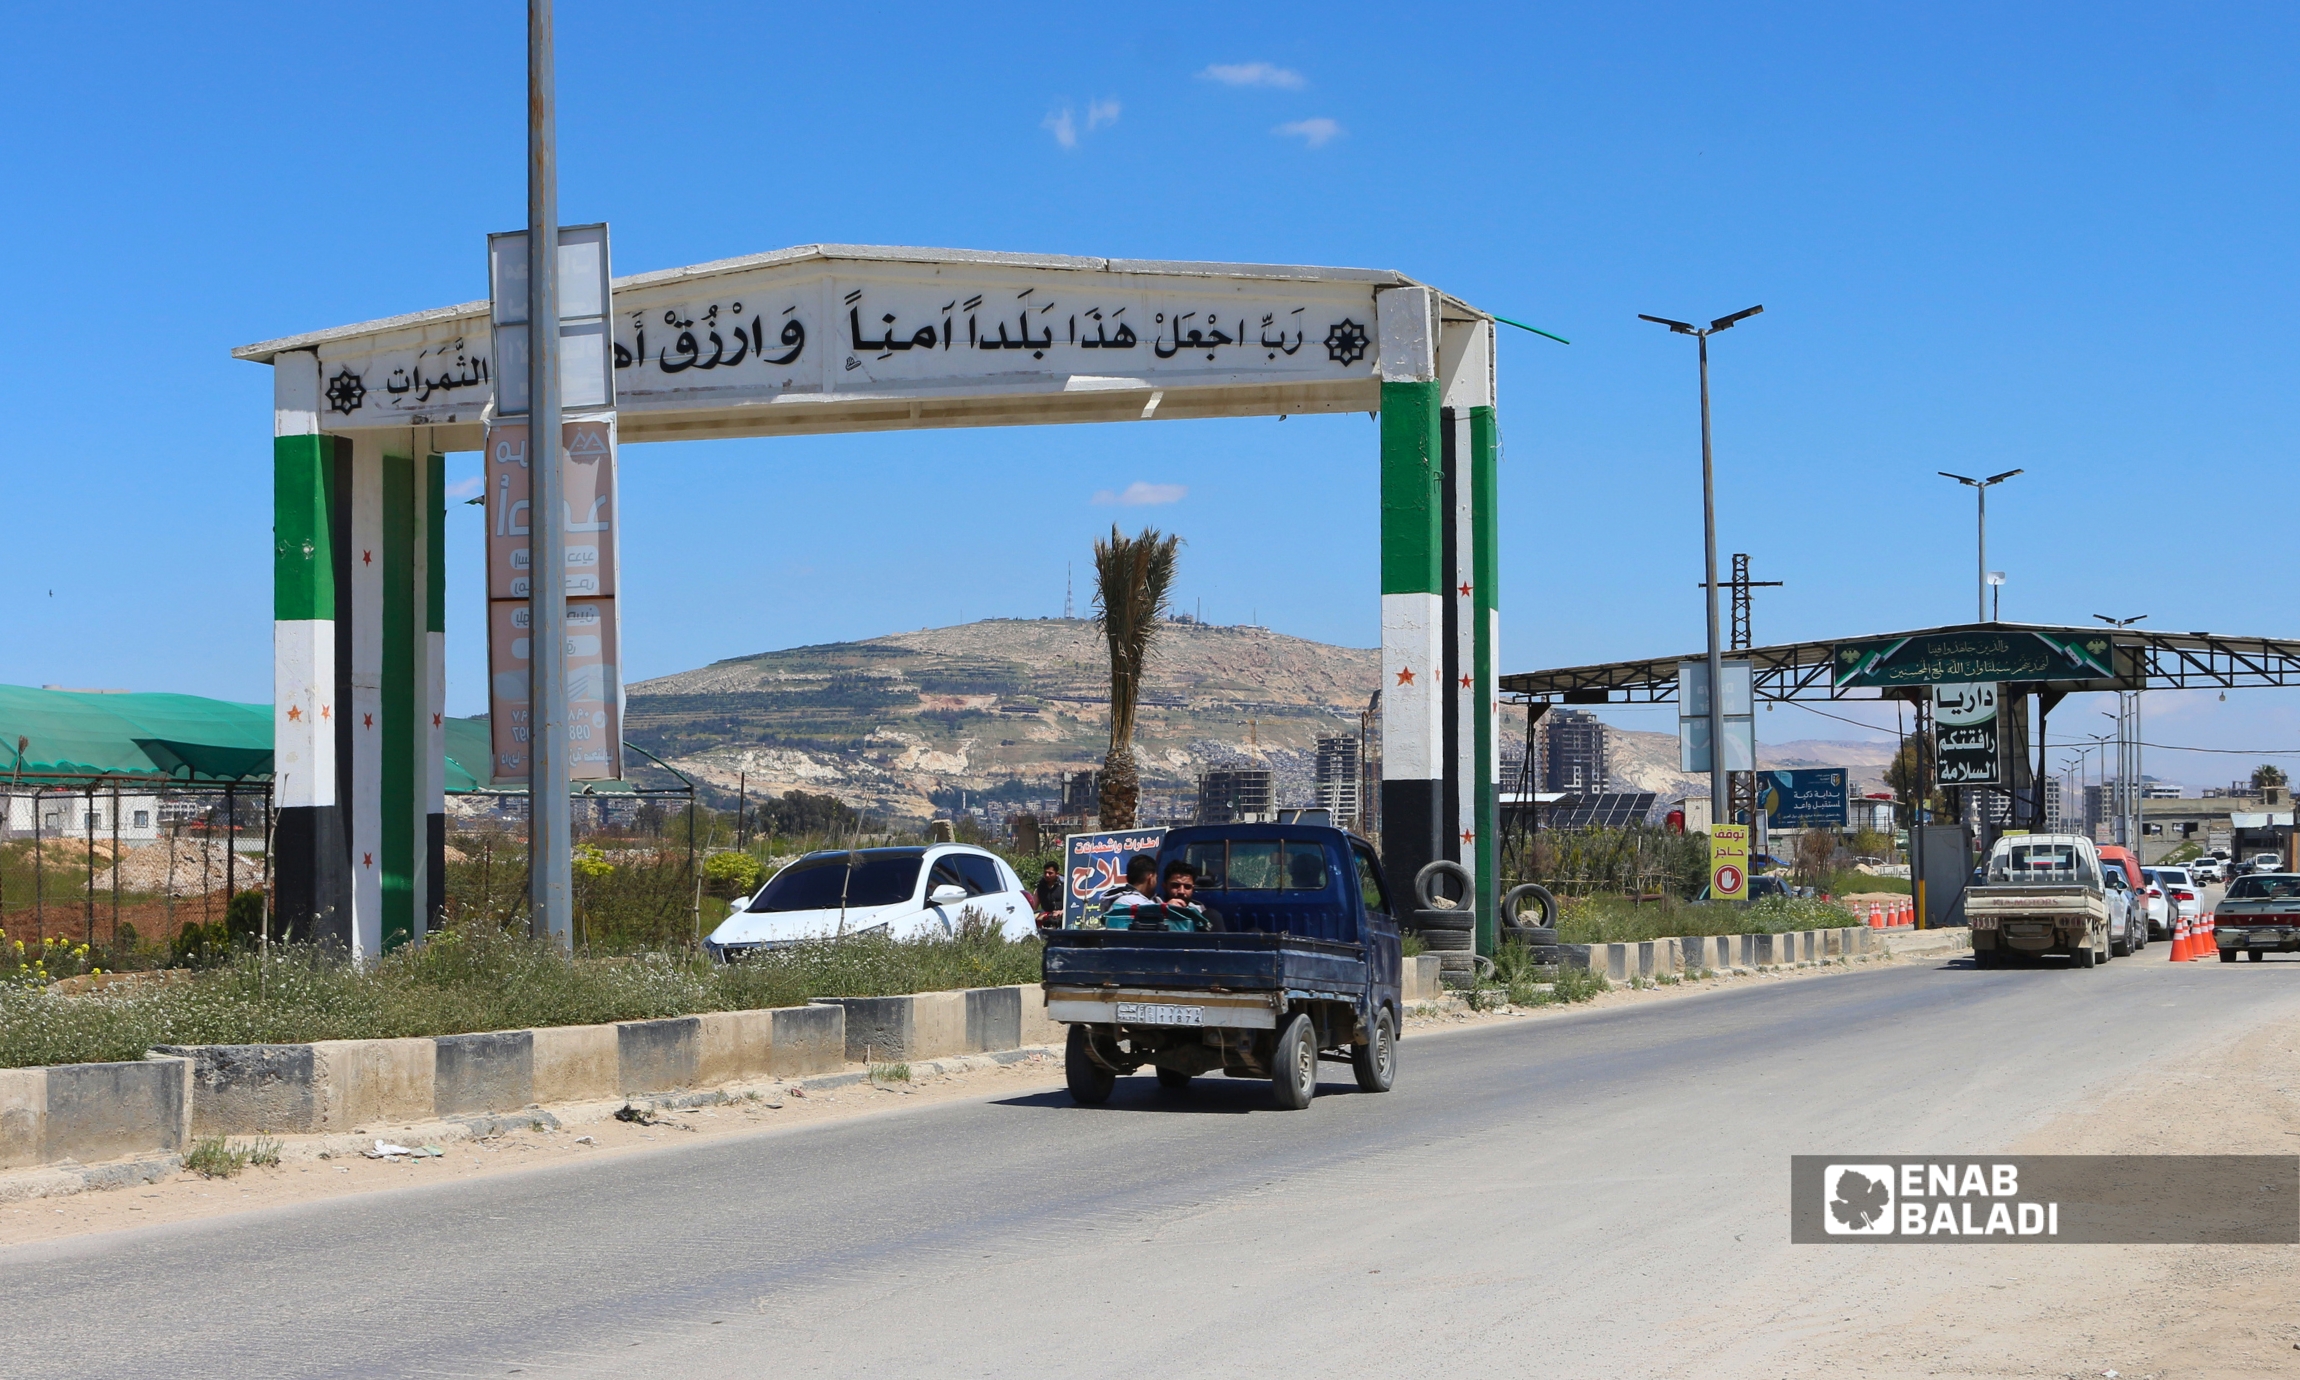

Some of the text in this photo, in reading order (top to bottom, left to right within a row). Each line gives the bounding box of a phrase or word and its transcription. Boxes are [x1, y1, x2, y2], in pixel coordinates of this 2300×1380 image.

[1936, 686, 1994, 715] داريا
[1938, 728, 1996, 757] رافقتكم
[1939, 759, 1996, 781] السلامة
[1714, 829, 1745, 842] توقف
[1714, 846, 1745, 859] حاجز
[1072, 856, 1129, 900] لاح
[1159, 1015, 1201, 1023] 11874
